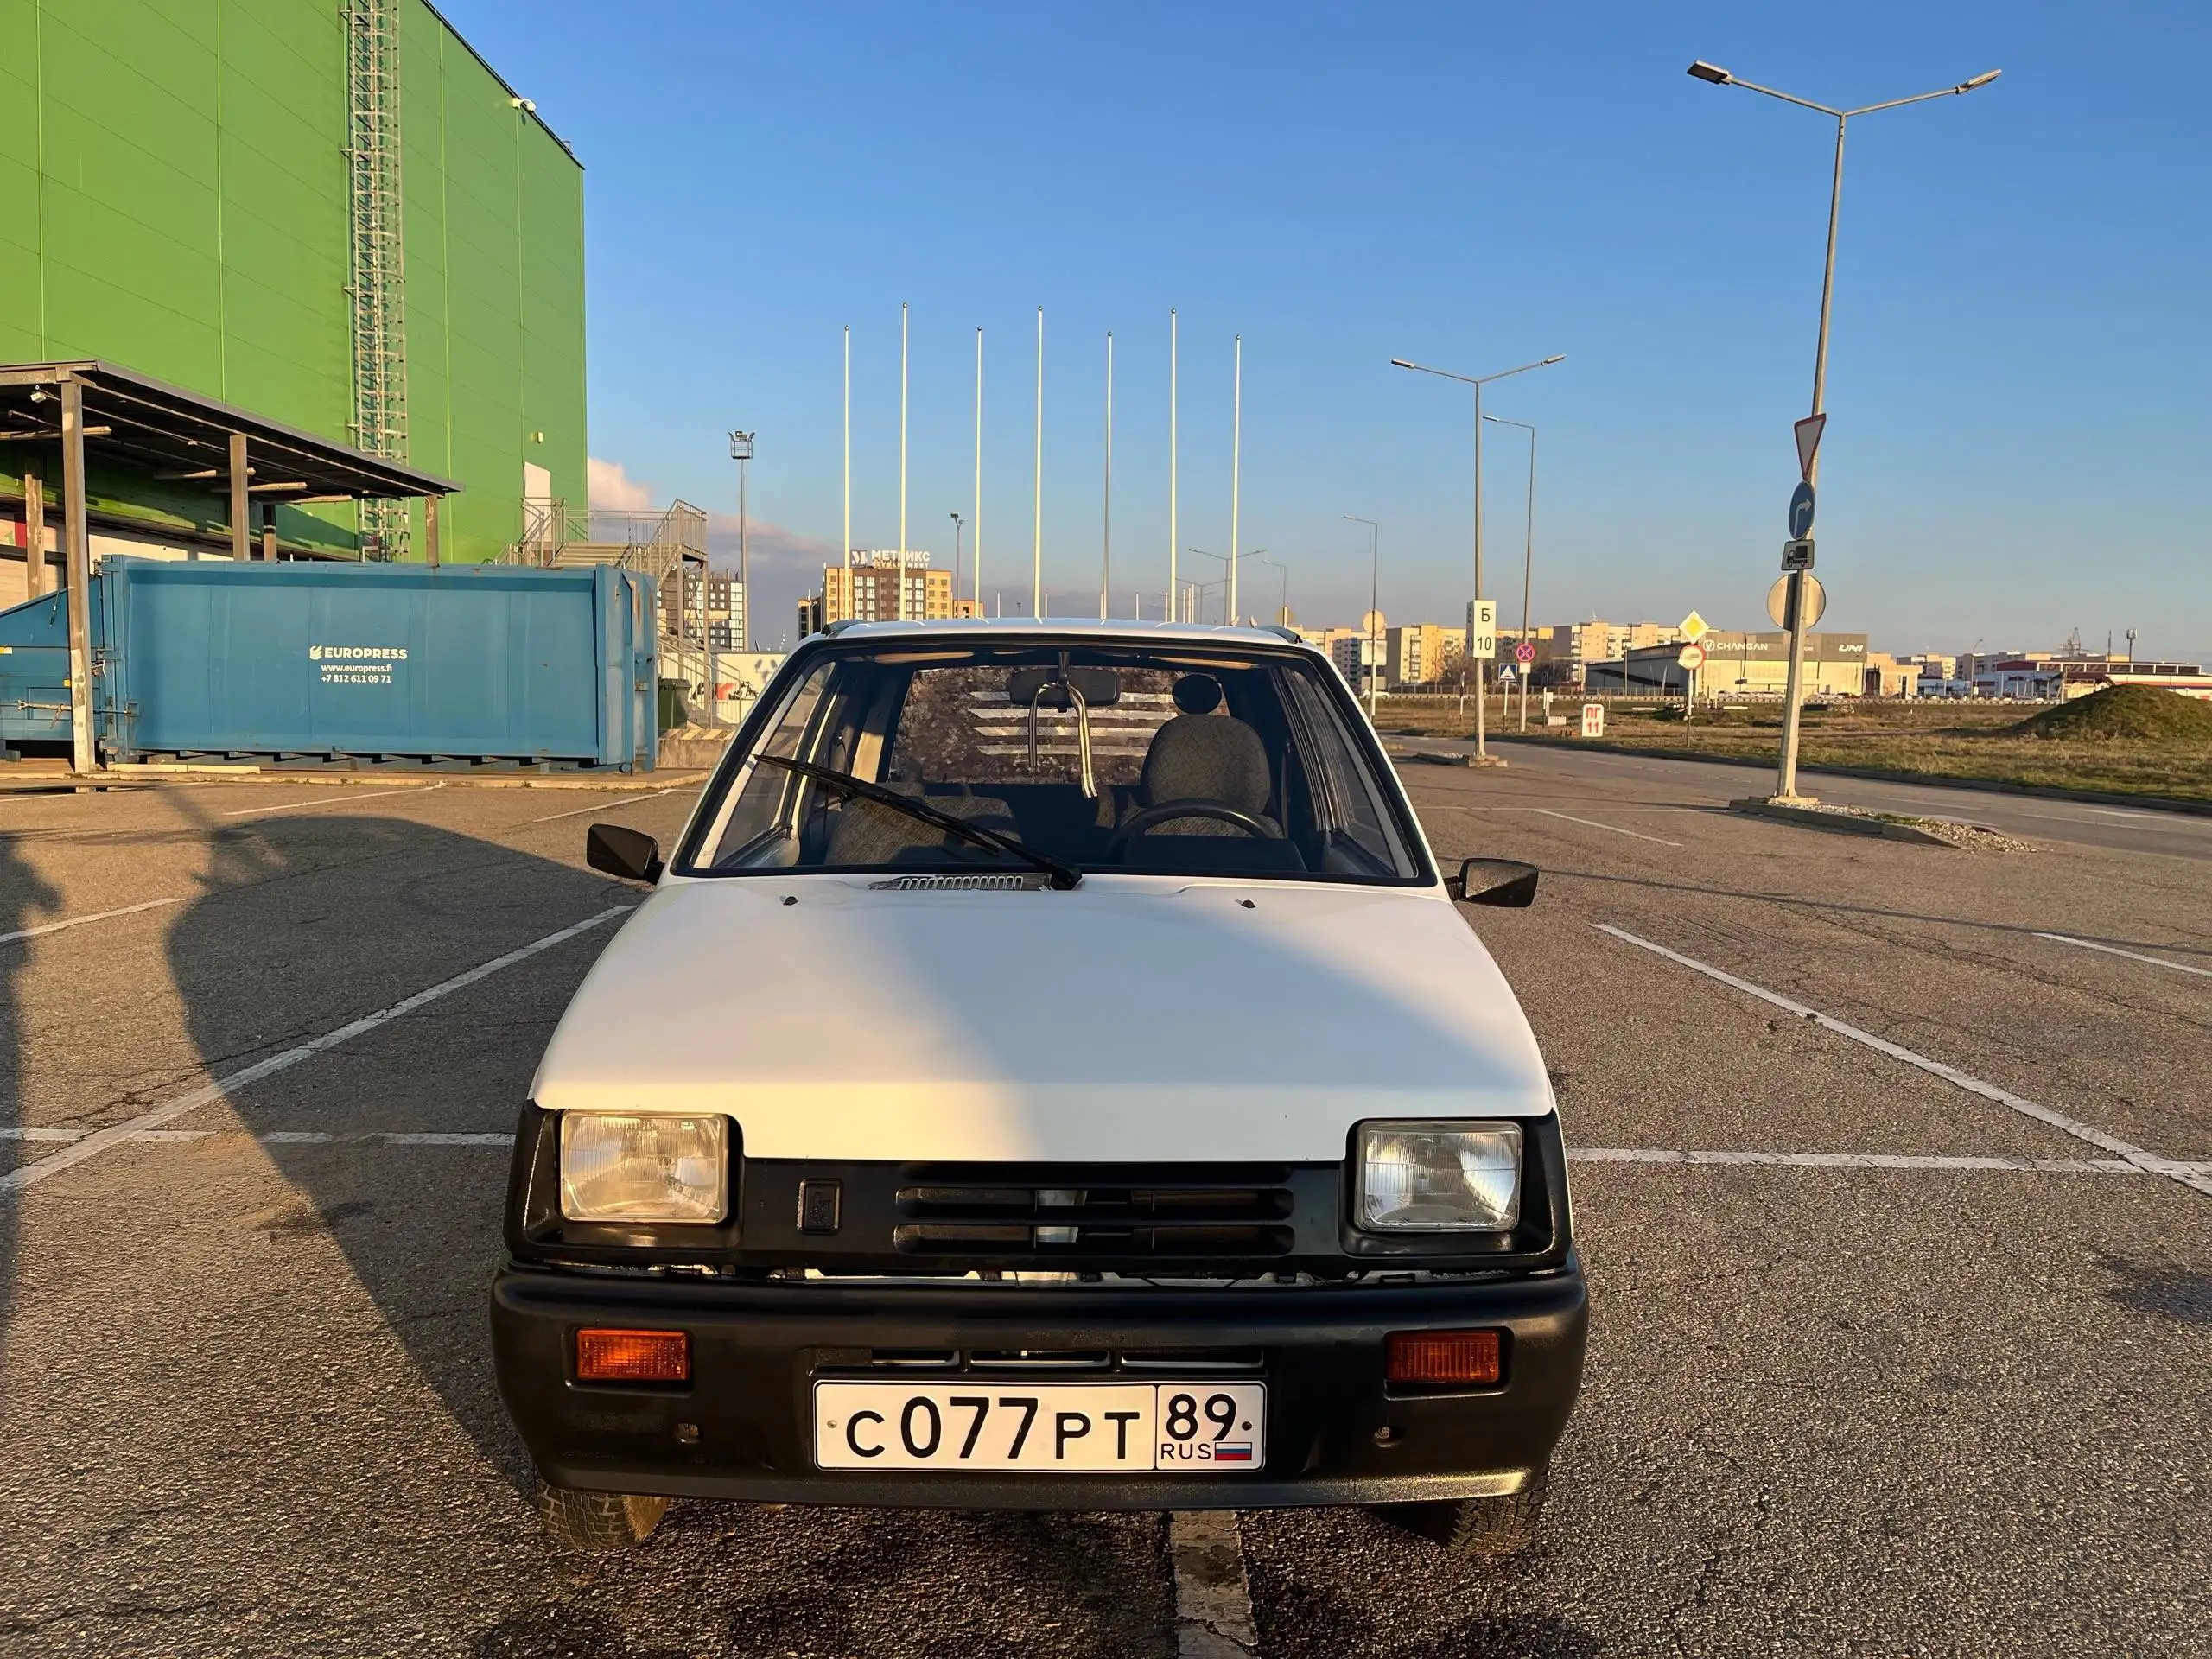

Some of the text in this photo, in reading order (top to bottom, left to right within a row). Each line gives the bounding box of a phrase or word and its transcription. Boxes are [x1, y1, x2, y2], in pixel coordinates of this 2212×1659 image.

[1481, 607, 1491, 622] Б
[1477, 636, 1491, 651] 10
[1716, 642, 1769, 651] CHANGAN
[1838, 644, 1864, 652] UNI
[324, 646, 408, 660] EUROPRESS
[321, 663, 392, 674] www.europress.fi
[351, 675, 366, 683] 611
[368, 675, 378, 683] 09
[381, 675, 391, 683] 71
[1586, 707, 1601, 719] ПГ
[1586, 721, 1599, 734] 11
[845, 1393, 1237, 1459] С077РТ 89
[1160, 1442, 1211, 1460] RUS
